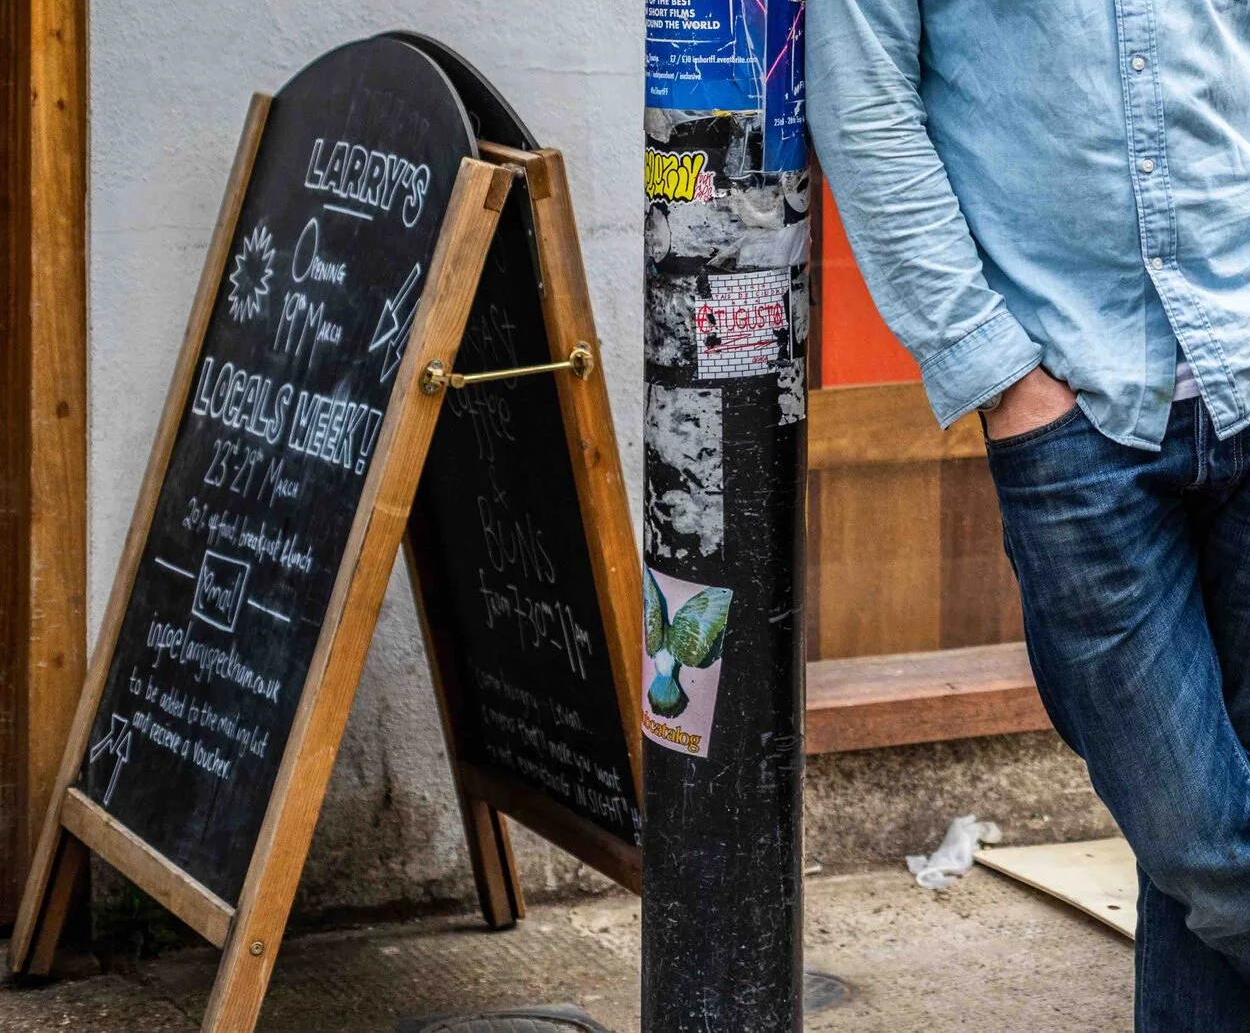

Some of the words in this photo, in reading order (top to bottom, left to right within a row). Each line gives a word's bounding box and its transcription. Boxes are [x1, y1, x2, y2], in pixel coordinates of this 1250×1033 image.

[648, 7, 668, 17] SHORT
[669, 8, 696, 19] FILMS
[664, 20, 680, 30] THE
[681, 20, 721, 30] WORLD
[304, 137, 431, 228] LARRY'S
[191, 356, 293, 445] LOCALS
[288, 389, 383, 476] WEEK!
[237, 514, 284, 564] breakfast
[287, 532, 314, 575] lunch
[129, 665, 143, 696] to
[145, 675, 160, 703] be
[159, 686, 188, 719] added
[187, 696, 200, 725] to
[200, 700, 218, 731] the
[250, 725, 270, 758] list
[132, 710, 151, 734] and
[181, 739, 191, 761] a
